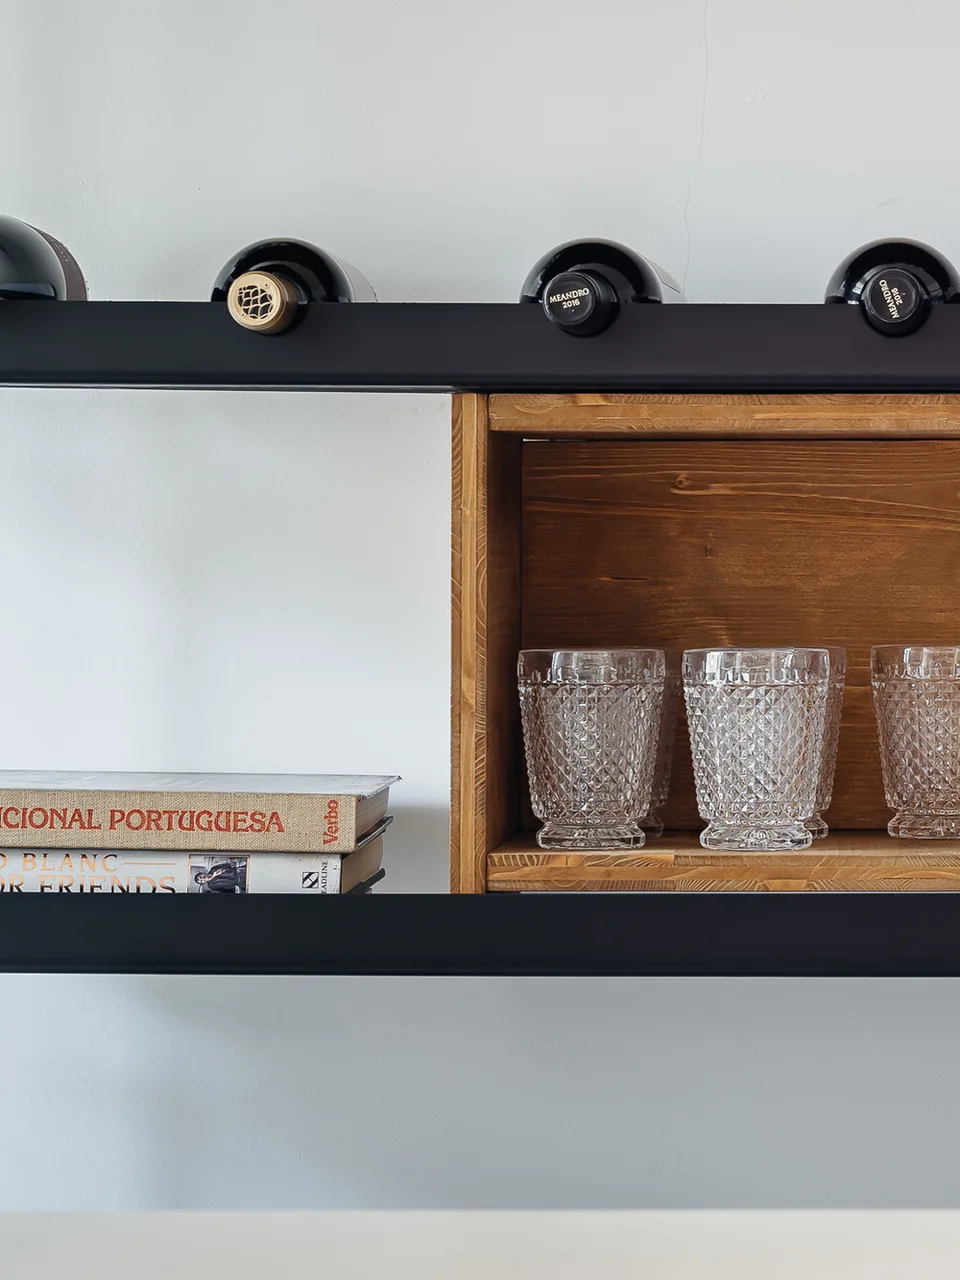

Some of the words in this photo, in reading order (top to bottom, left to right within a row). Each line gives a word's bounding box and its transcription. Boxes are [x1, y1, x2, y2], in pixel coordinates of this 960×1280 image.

[549, 287, 590, 303] MEANDRO
[562, 298, 580, 309] 2016
[879, 279, 900, 319] MEANDRO
[109, 807, 285, 833] PORTUGUESA
[322, 799, 339, 845] Verbo
[22, 852, 118, 872] BLANC
[39, 875, 177, 894] FRIENDS
